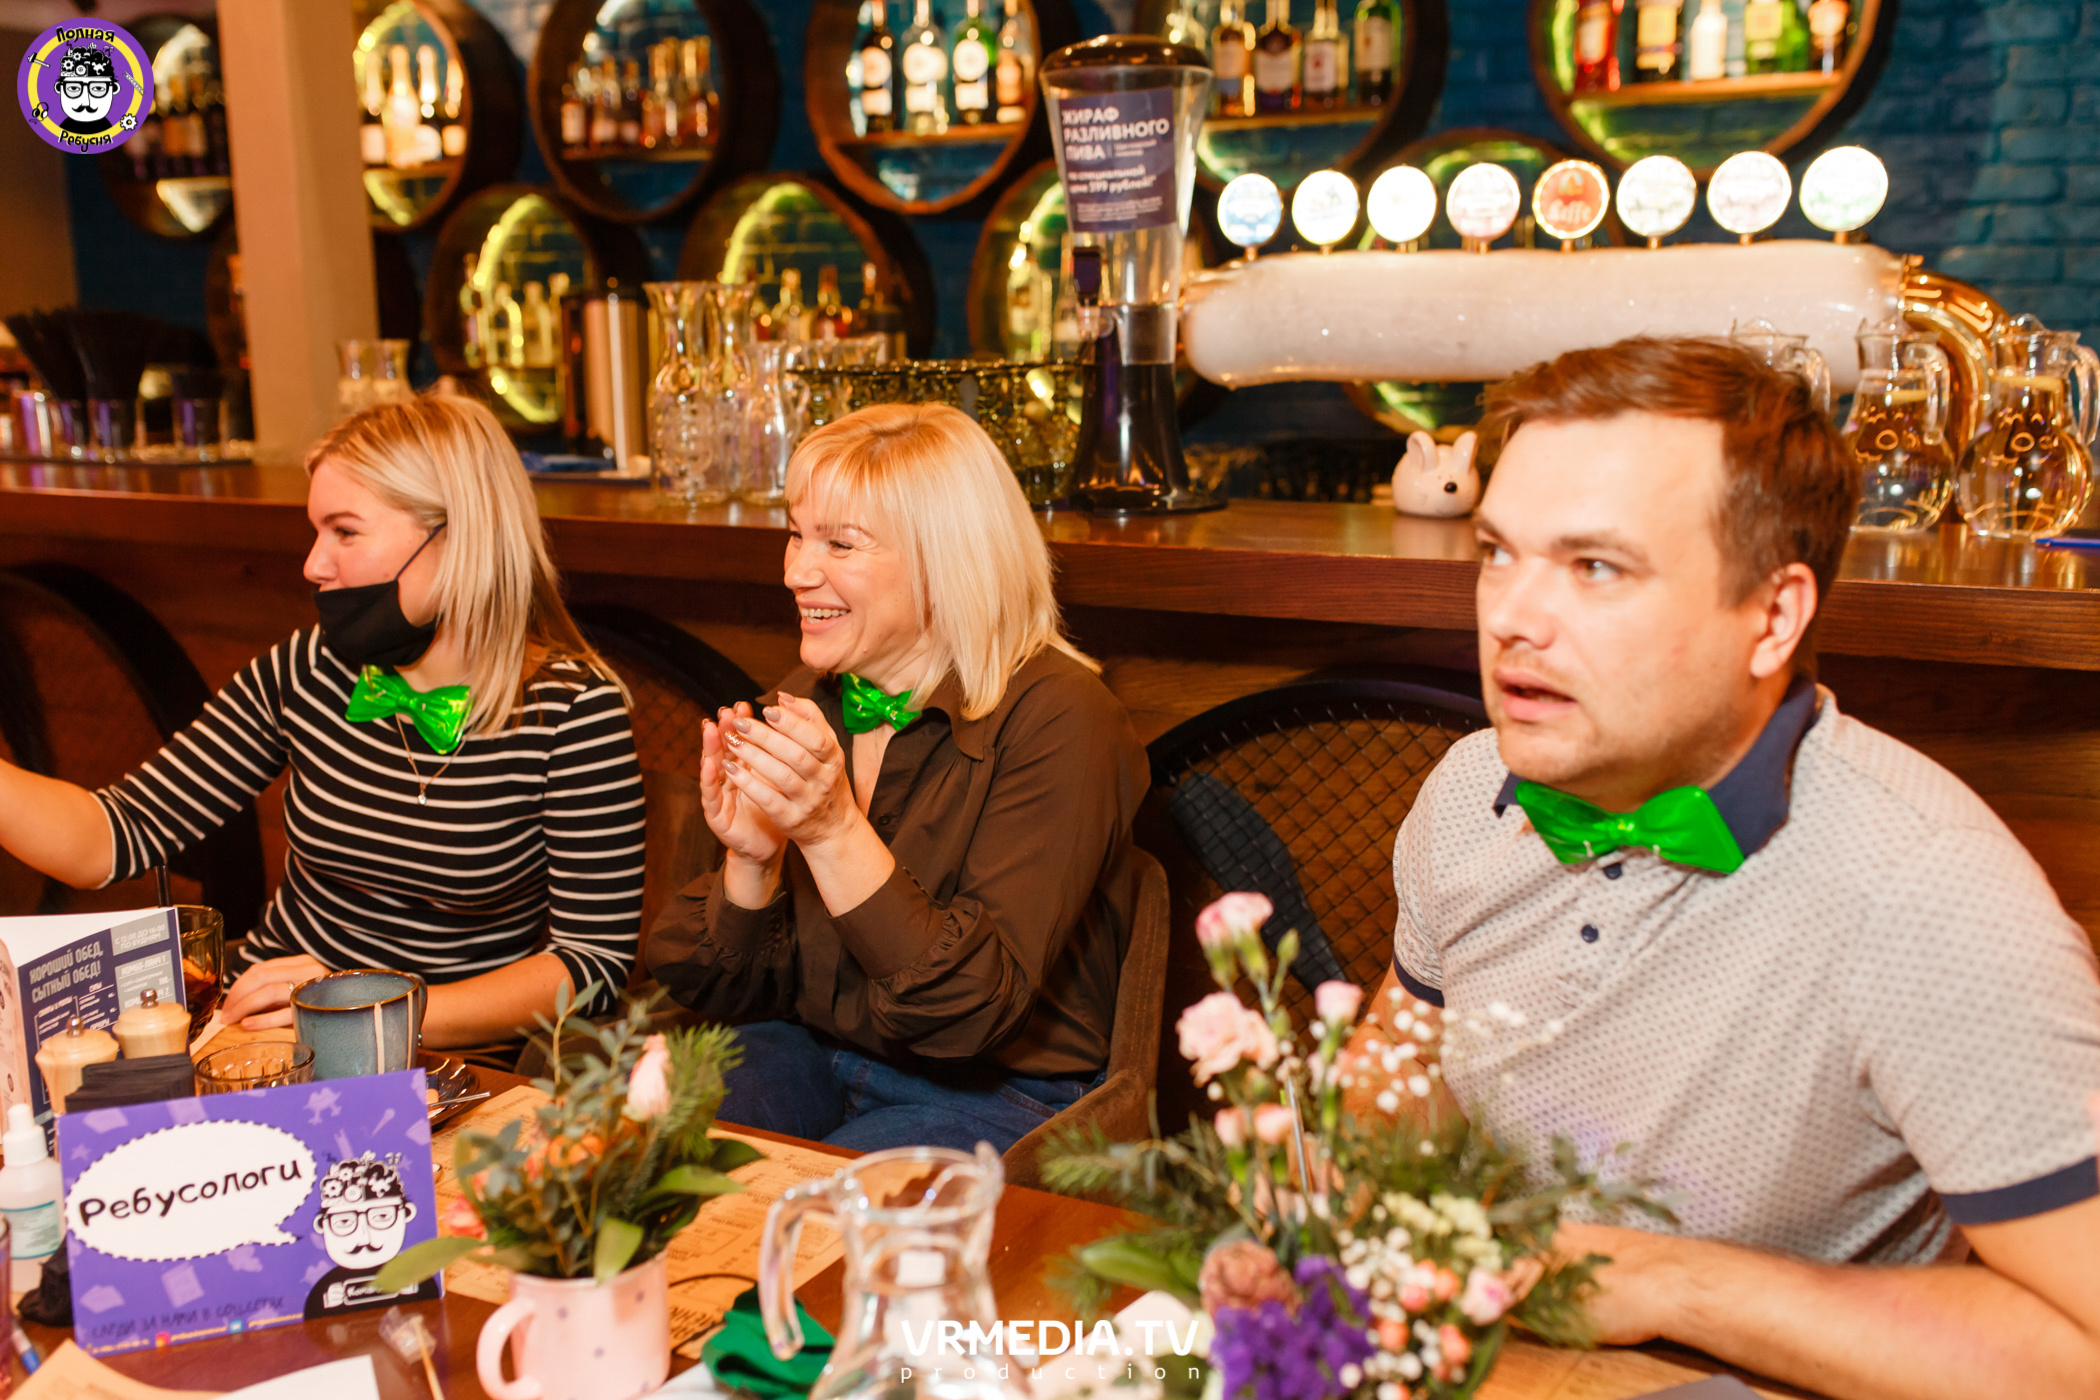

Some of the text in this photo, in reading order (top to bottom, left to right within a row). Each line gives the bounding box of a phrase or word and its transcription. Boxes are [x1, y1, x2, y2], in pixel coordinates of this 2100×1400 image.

[1062, 106, 1120, 125] ЖИРАФ
[1063, 117, 1170, 142] РАЗЛИВНОГО
[1065, 144, 1106, 161] ПИВА
[29, 948, 74, 985] ХОРОШИЙ
[31, 969, 71, 1004] СЫТНЫЙ
[78, 1158, 302, 1228] Ребусологи
[161, 1310, 198, 1327] НАМИ
